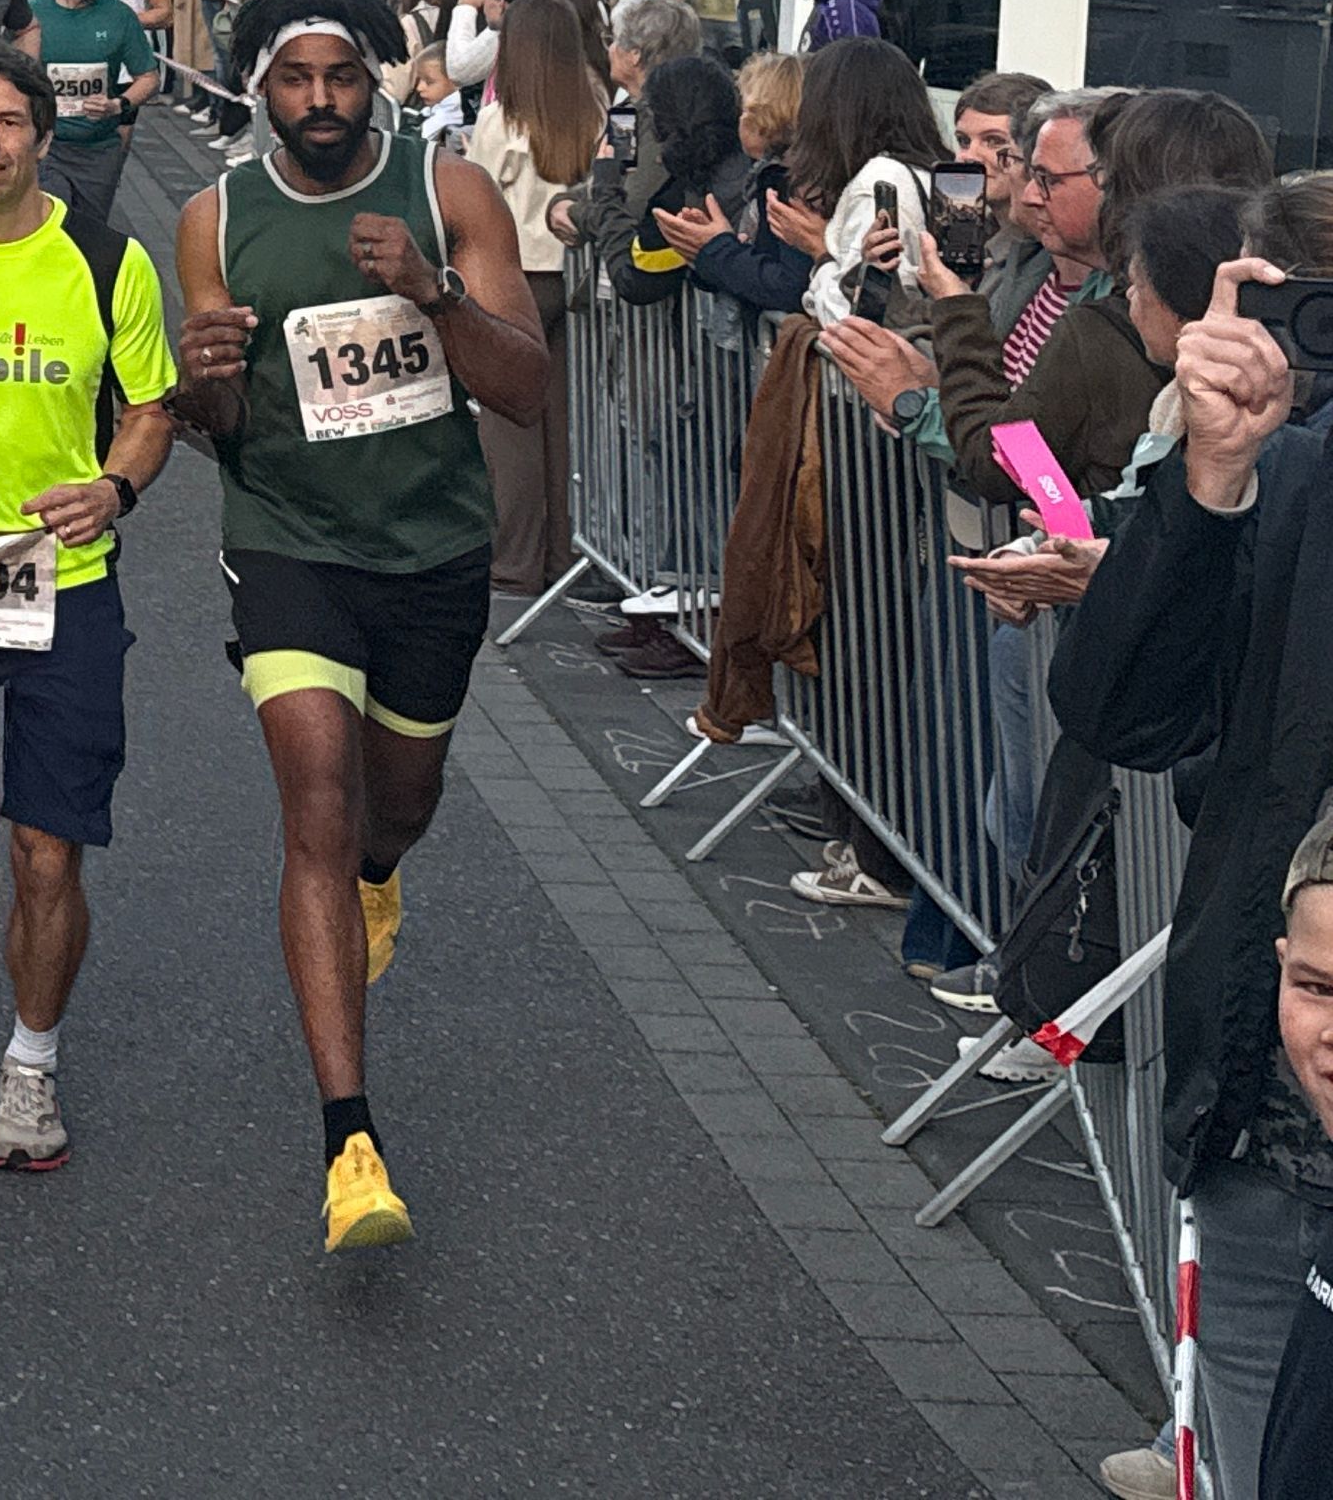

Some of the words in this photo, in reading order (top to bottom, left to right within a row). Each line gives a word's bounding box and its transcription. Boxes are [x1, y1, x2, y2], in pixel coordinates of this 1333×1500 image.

[54, 78, 103, 97] 2509
[27, 335, 65, 346] Leben
[308, 331, 430, 391] 1345
[312, 402, 373, 423] VOSS
[315, 426, 346, 440] BEW
